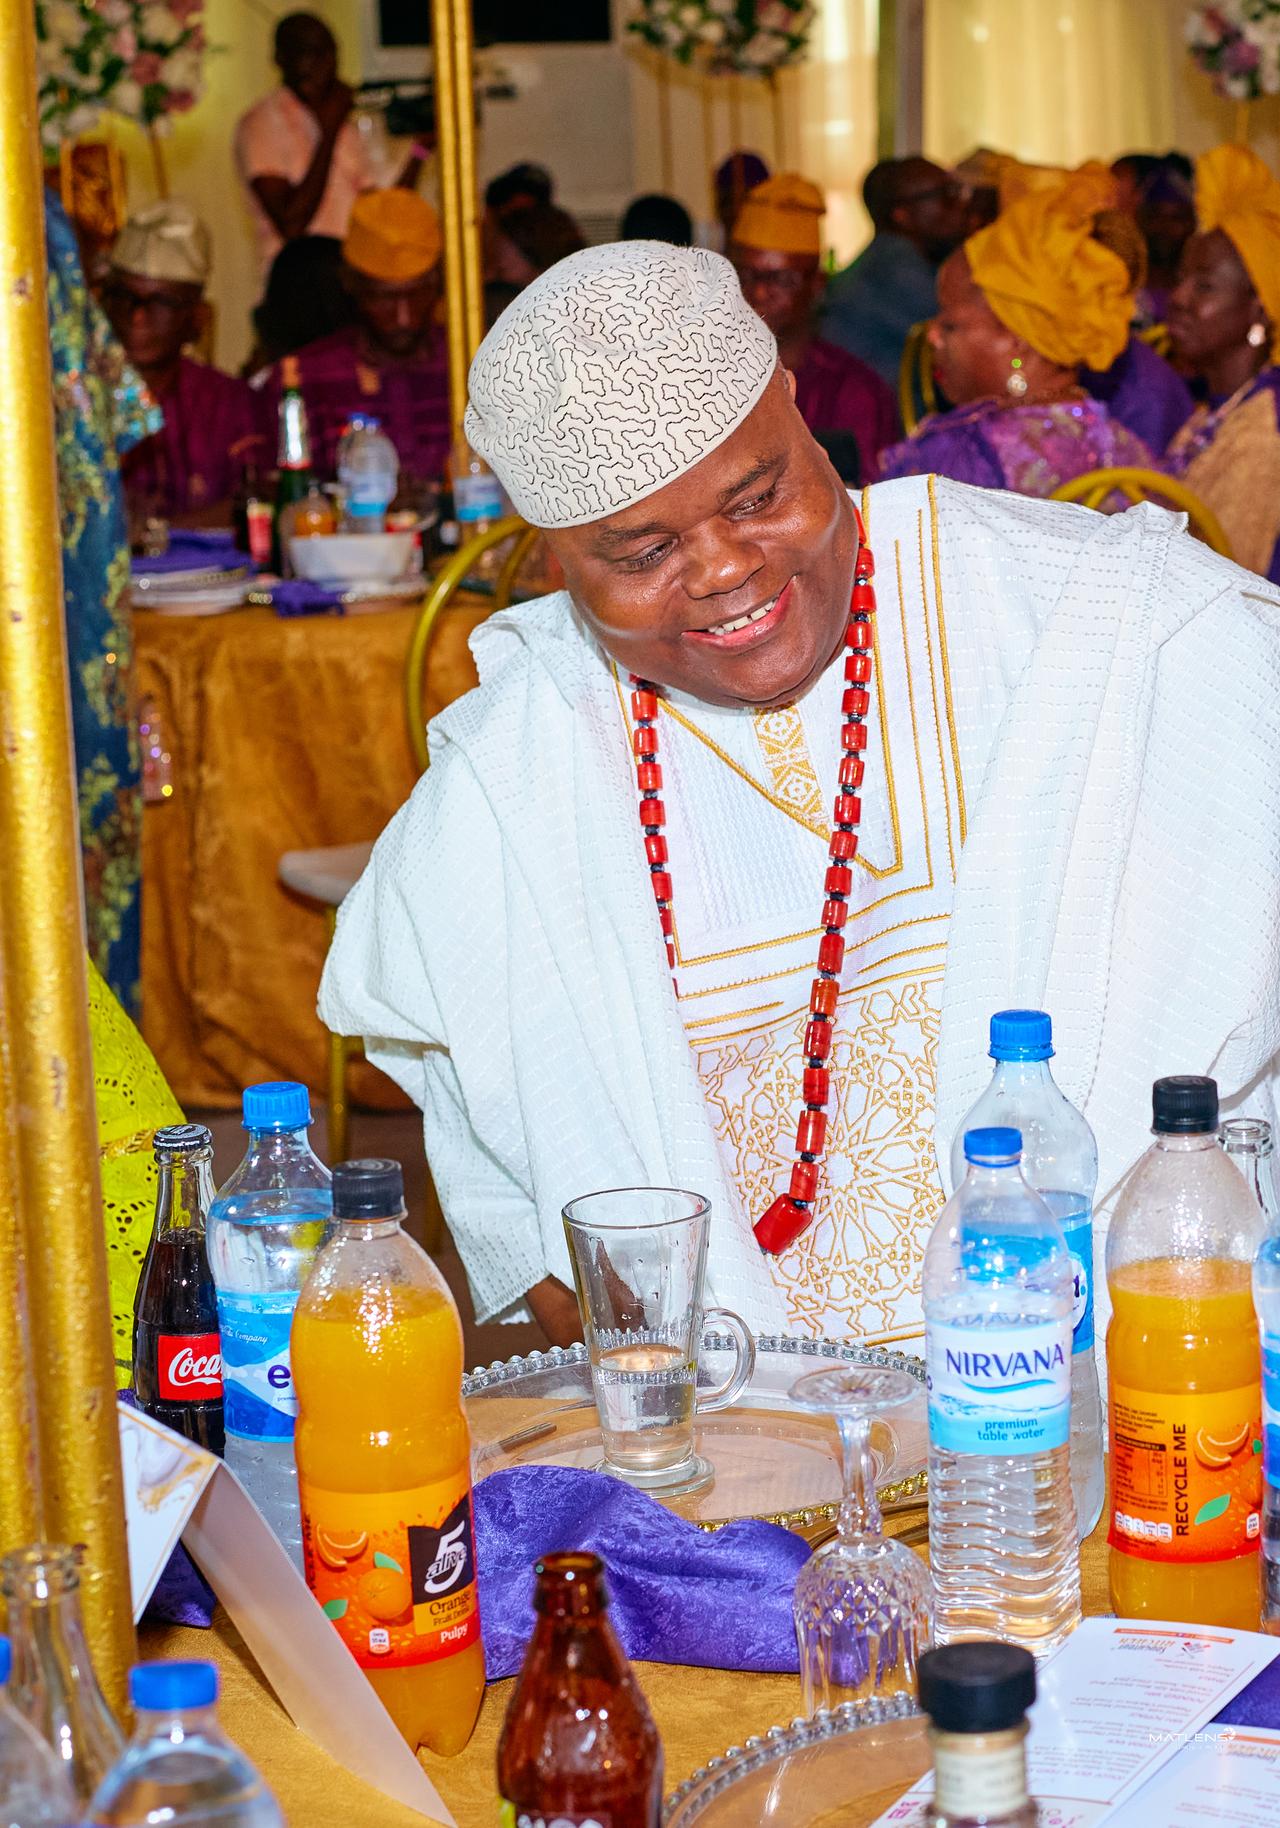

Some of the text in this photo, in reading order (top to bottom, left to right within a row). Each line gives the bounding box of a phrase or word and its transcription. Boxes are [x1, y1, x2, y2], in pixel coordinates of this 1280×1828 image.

[168, 1348, 221, 1386] Coca
[945, 1343, 1064, 1377] NIRVANA
[977, 1428, 1045, 1441] table water
[985, 1418, 1038, 1431] premium
[1173, 1424, 1189, 1536] RECYCLE ME
[426, 1546, 467, 1580] alive
[430, 1590, 471, 1616] Orange
[440, 1623, 468, 1644] Pulpy
